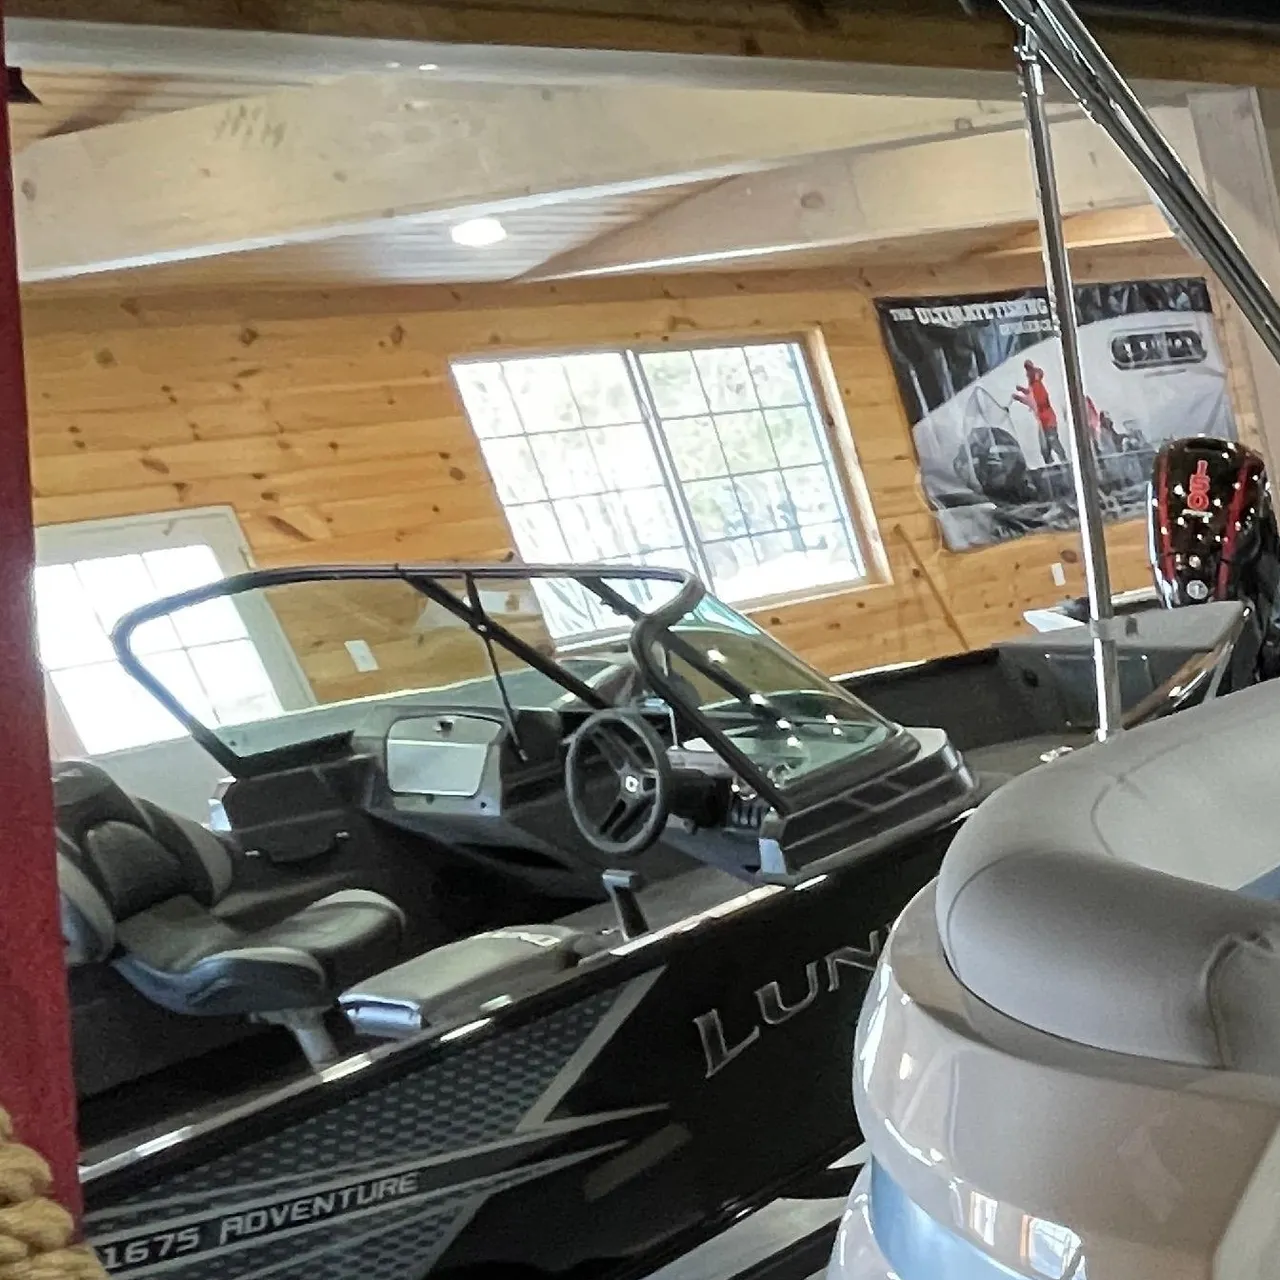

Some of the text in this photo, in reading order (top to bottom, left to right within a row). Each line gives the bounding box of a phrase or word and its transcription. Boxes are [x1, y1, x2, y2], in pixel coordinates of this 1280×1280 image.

[1187, 459, 1211, 511] 150
[693, 924, 893, 1079] LUN
[104, 1171, 422, 1270] 1675 ADVENTURE
